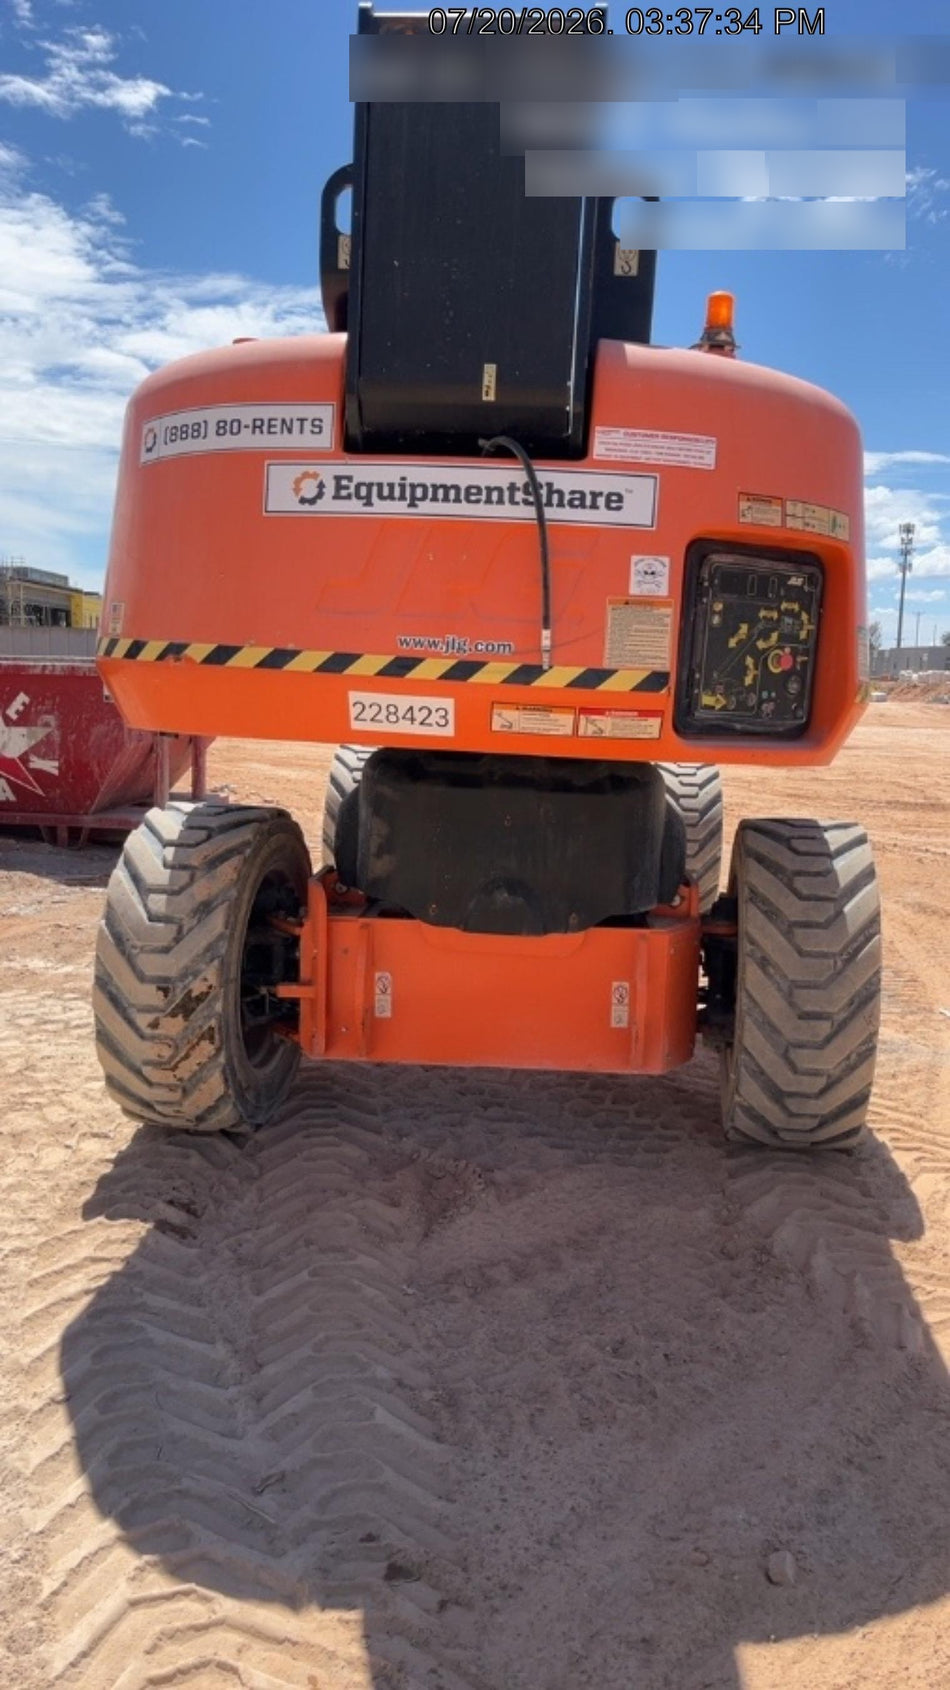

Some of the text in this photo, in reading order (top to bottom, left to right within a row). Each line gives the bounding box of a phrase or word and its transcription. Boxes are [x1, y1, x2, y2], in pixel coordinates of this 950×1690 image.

[163, 417, 323, 446] (888) 80-RENTS
[398, 635, 513, 654] www.jlg.com
[352, 701, 450, 729] 228423
